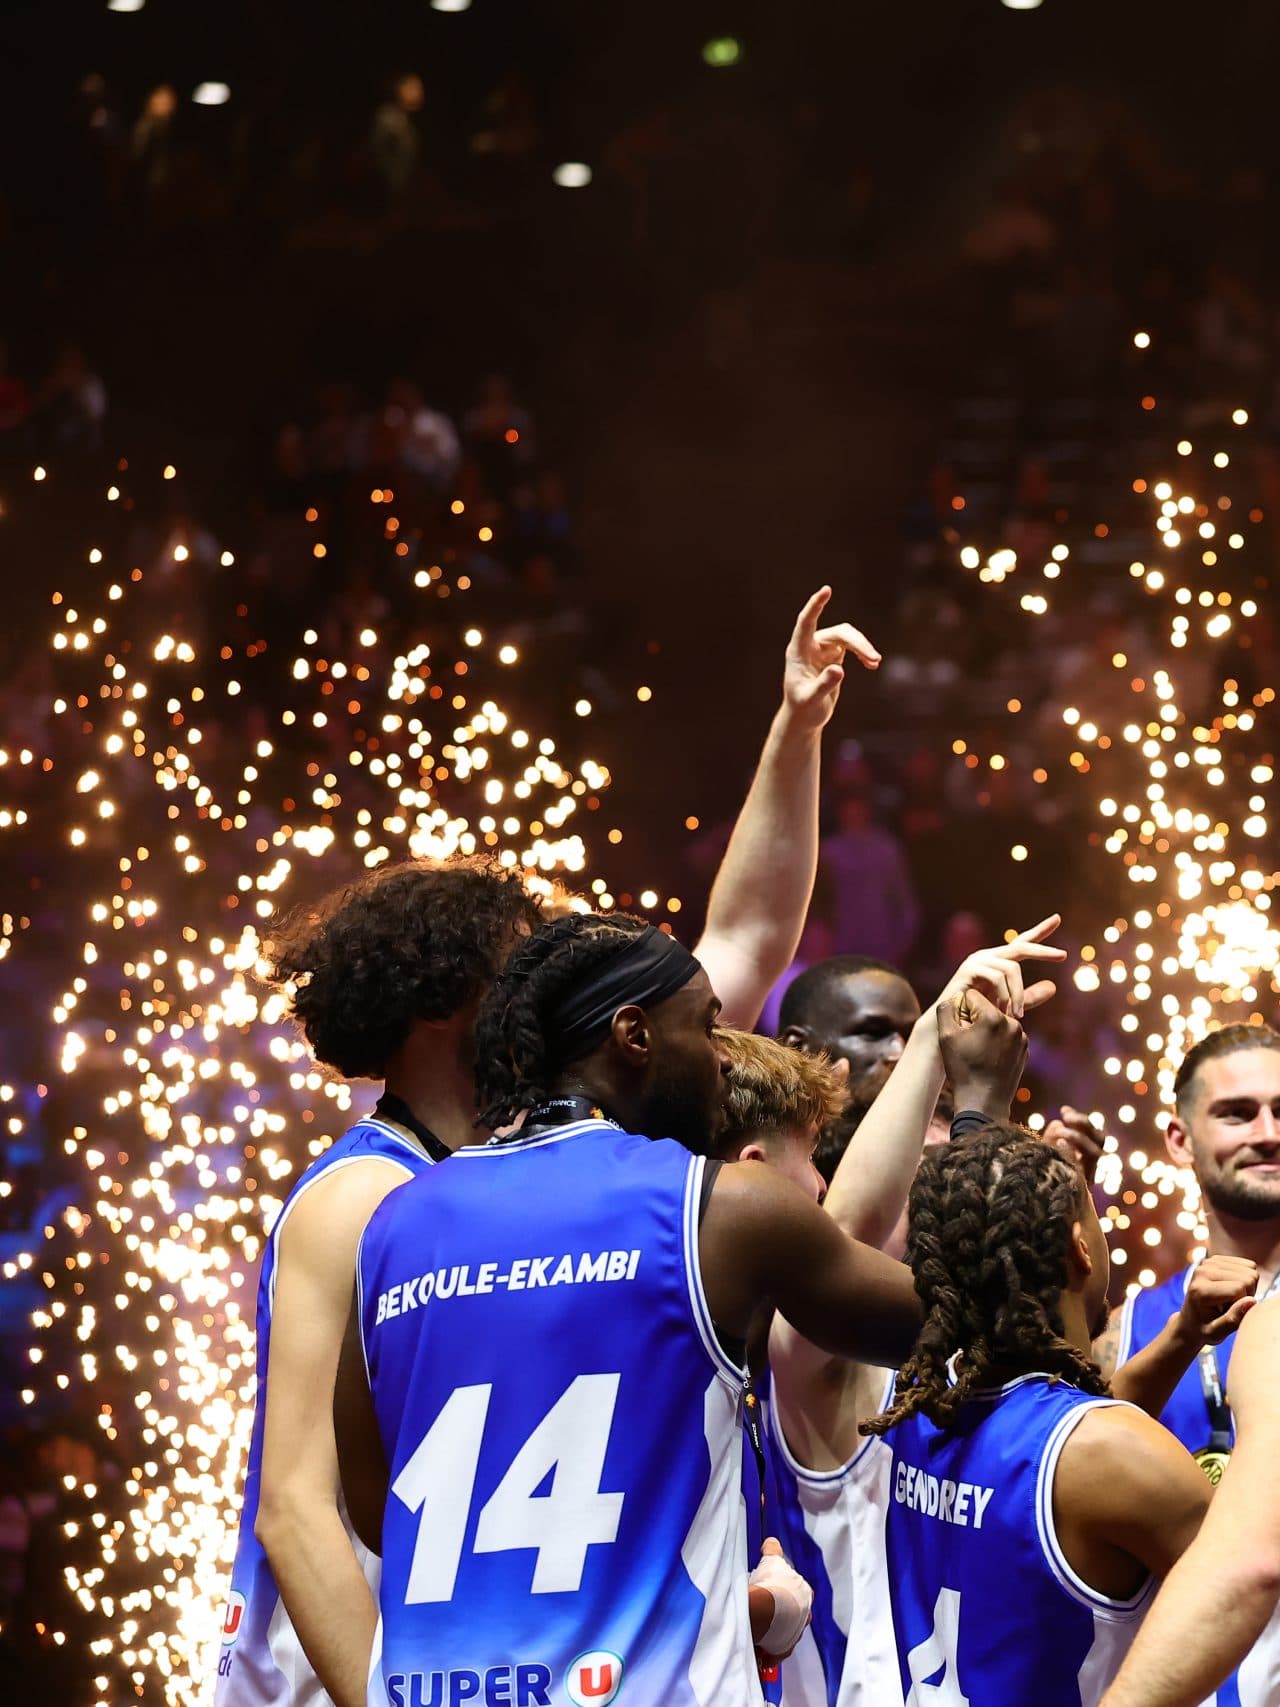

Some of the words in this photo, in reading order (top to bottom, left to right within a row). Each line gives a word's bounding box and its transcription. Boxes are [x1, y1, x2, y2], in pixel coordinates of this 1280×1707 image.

[375, 1250, 641, 1326] BEKOULE-EKAMBI
[391, 1373, 625, 1605] 14
[895, 1461, 995, 1529] GENDREY
[388, 1664, 552, 1707] SUPER
[580, 1664, 611, 1697] U
